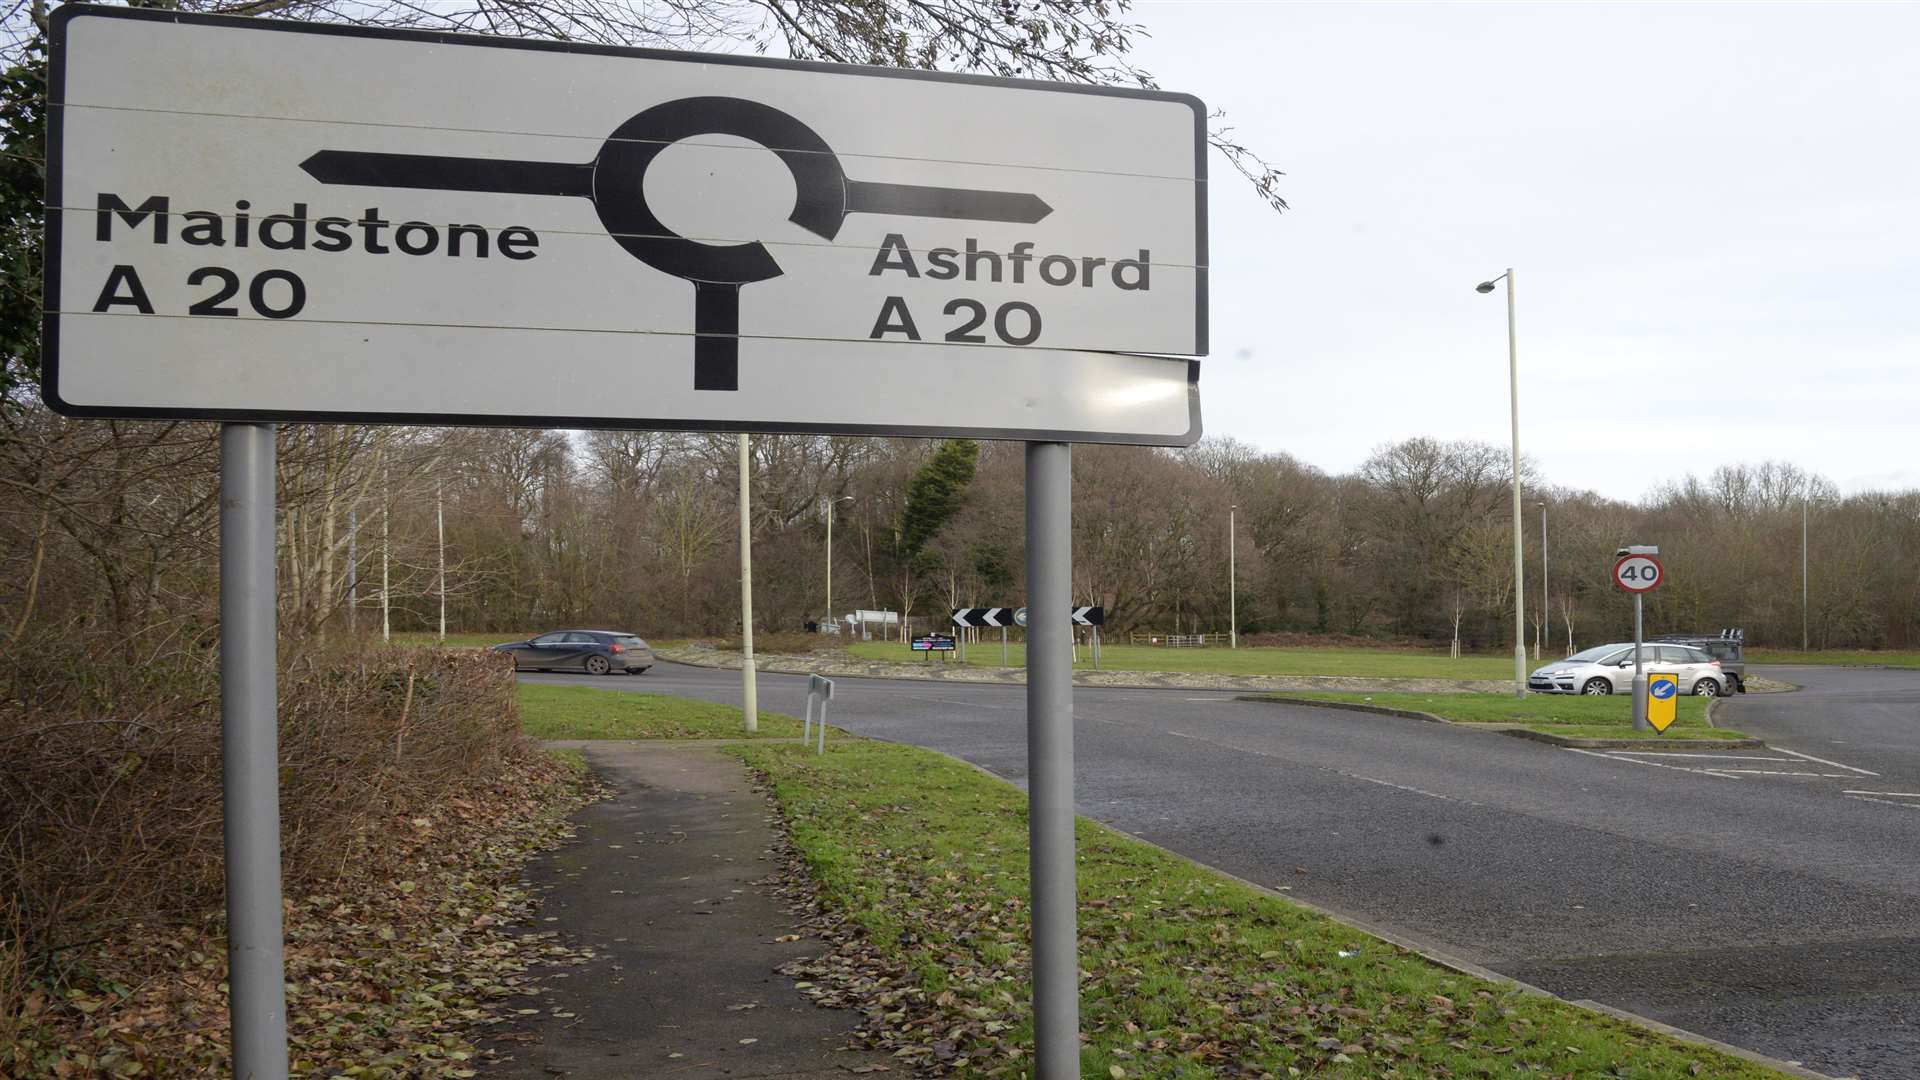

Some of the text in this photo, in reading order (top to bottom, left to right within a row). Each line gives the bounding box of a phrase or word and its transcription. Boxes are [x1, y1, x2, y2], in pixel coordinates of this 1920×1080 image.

[96, 192, 540, 261] Maidstone
[868, 232, 1151, 292] Ashford
[92, 264, 307, 319] A 20
[868, 295, 1043, 346] A 20
[1620, 565, 1658, 582] 40
